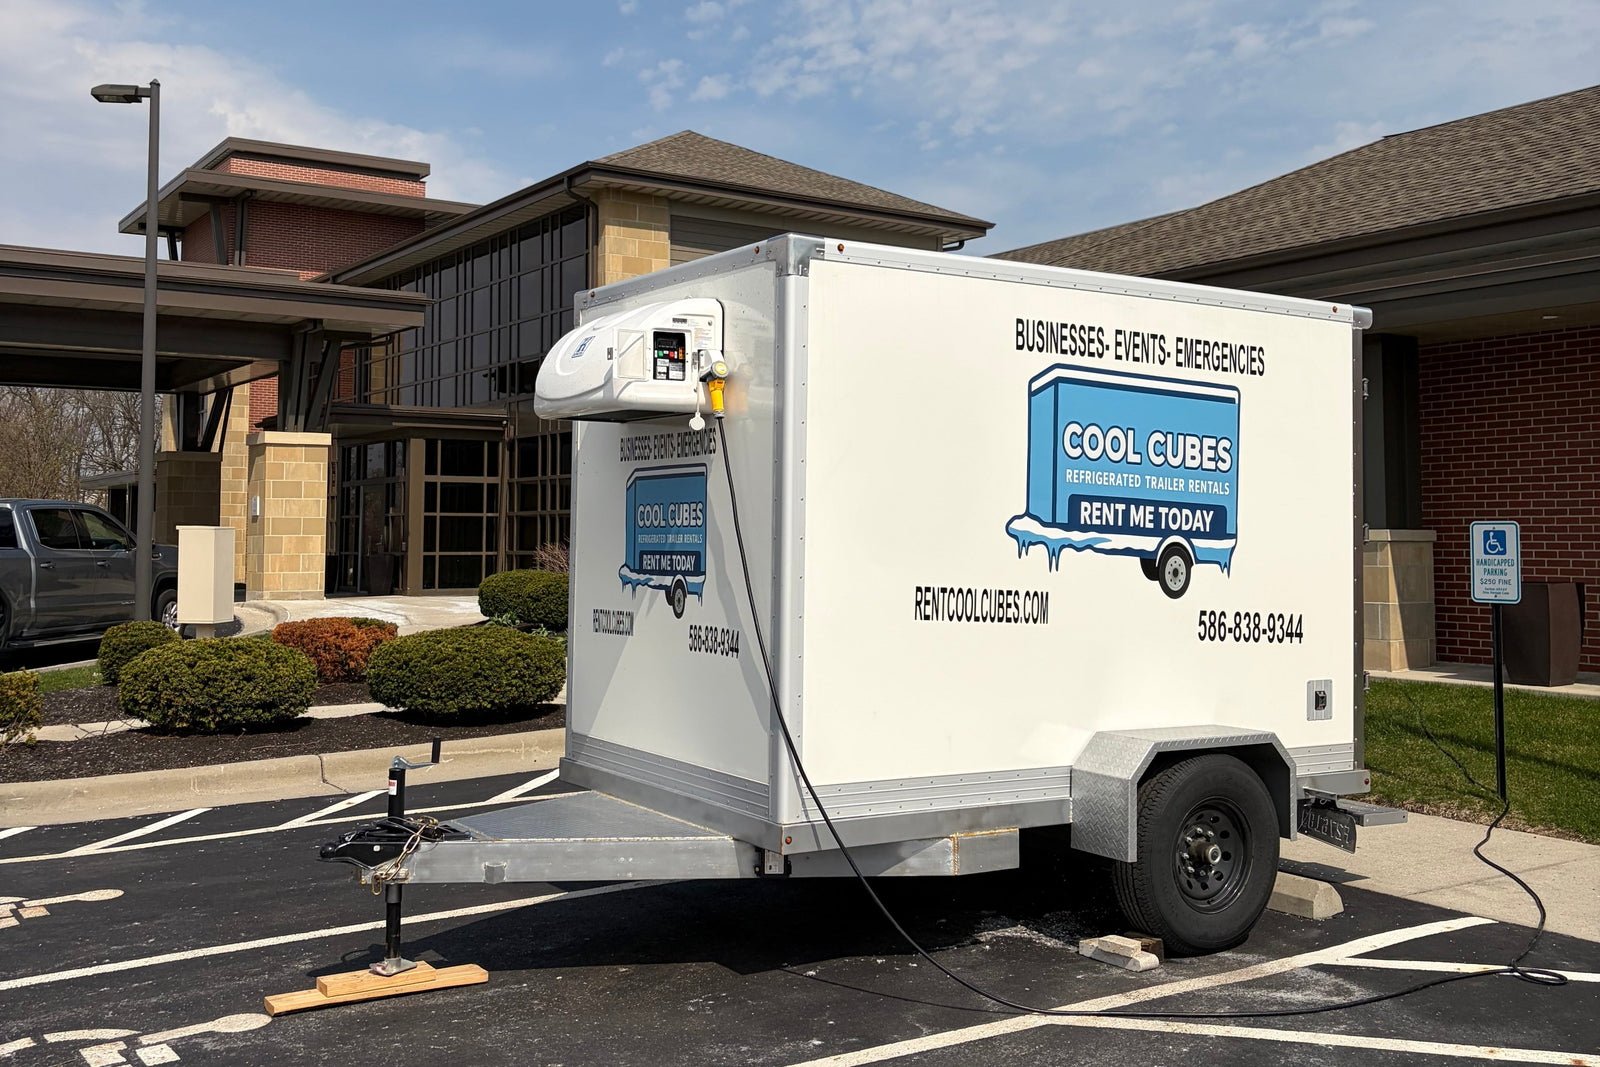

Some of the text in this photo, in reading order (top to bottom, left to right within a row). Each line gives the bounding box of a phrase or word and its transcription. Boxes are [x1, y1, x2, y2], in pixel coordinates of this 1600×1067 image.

[1175, 336, 1266, 376] EMERGENCIES
[677, 427, 717, 458] EMERGENCIES
[1063, 421, 1232, 472] COOL CUBES
[1065, 469, 1230, 495] REFRIGERATED TRAILER RENTALS
[637, 501, 703, 528] COOL CUBES
[1080, 501, 1214, 533] RENT ME TODAY
[638, 534, 702, 543] REFRIGERATED TRAILER RENTALS
[642, 554, 695, 571] RENT ME TODAY
[1476, 558, 1515, 567] HANDICAPPED
[1483, 568, 1507, 576] PARKING
[914, 585, 1049, 624] RENTCOOLCUBES.COM
[689, 624, 740, 659] 586-838-9344
[1198, 610, 1304, 644] 586-838-9344
